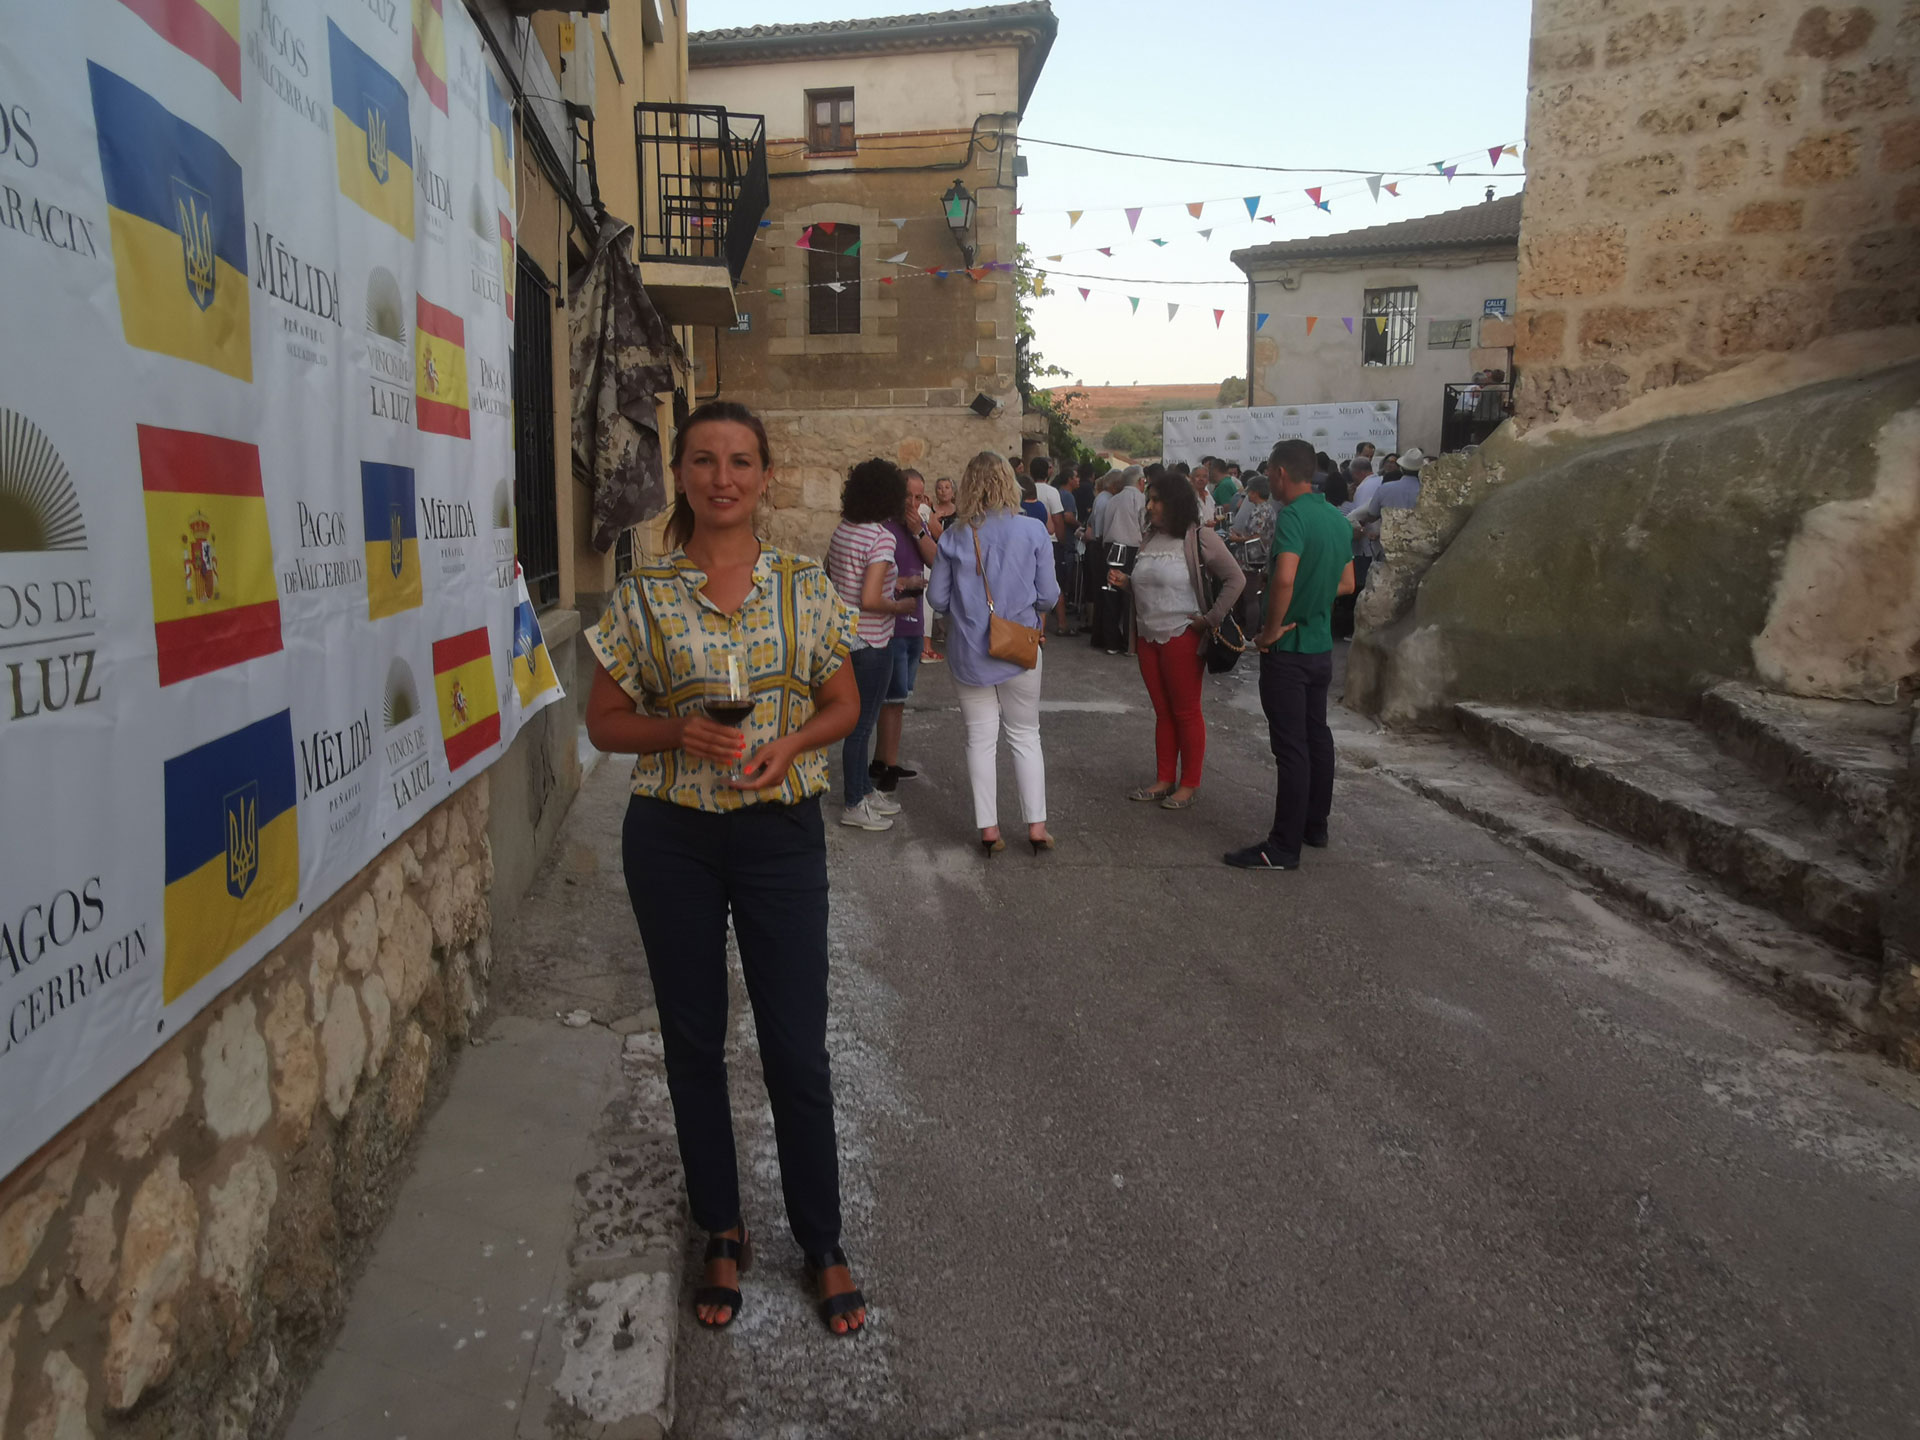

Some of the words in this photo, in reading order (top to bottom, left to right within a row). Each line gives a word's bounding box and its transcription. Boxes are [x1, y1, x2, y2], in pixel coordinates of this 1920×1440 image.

[369, 384, 389, 419] LA
[52, 577, 97, 623] DE
[6, 650, 102, 721] LUZ
[392, 775, 413, 811] LA
[409, 759, 436, 799] LUZ
